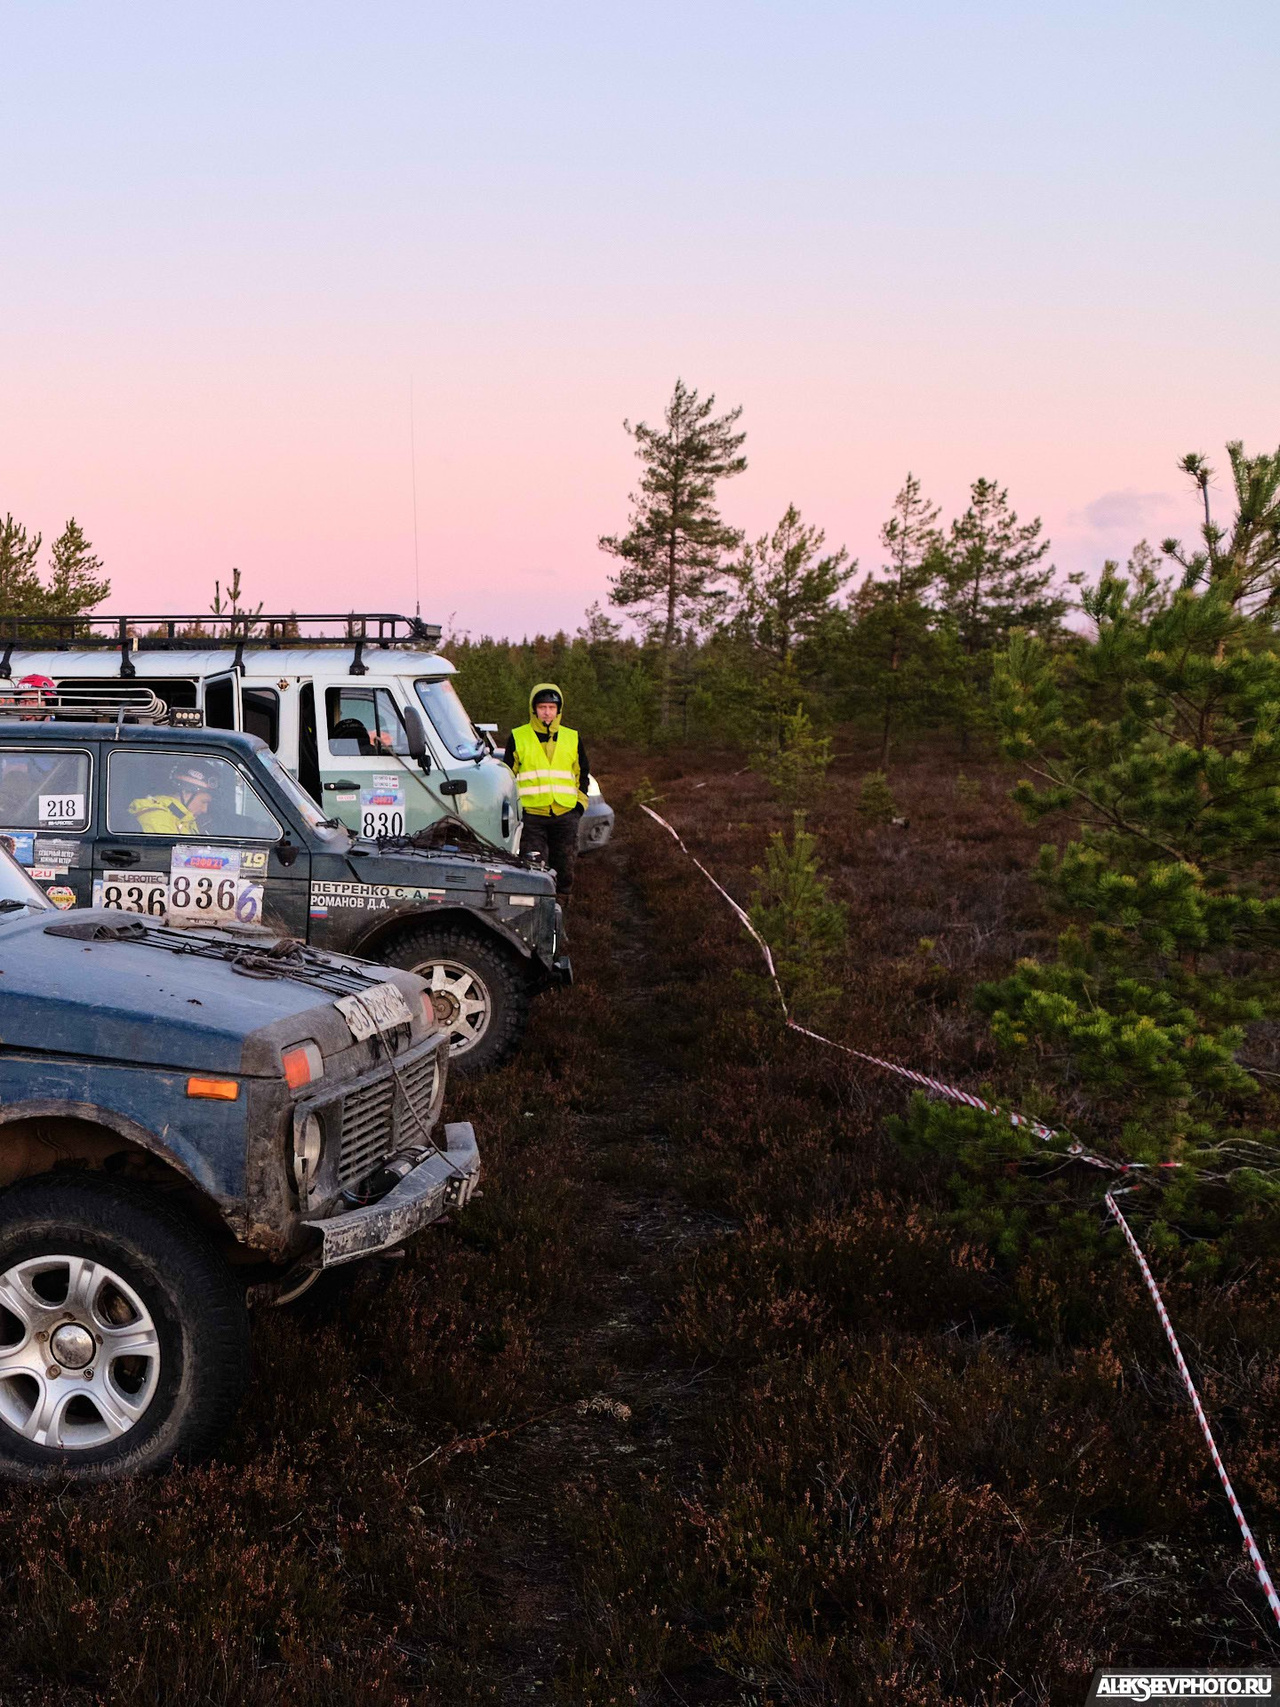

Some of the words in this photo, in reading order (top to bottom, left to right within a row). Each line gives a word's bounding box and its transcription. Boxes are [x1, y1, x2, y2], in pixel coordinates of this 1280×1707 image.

[47, 800, 76, 817] 218
[363, 812, 403, 838] 830
[172, 876, 235, 911] 836
[311, 882, 390, 897] ПЕТРЕНКО
[104, 886, 166, 916] 836
[310, 895, 364, 908] РОМАНОВ
